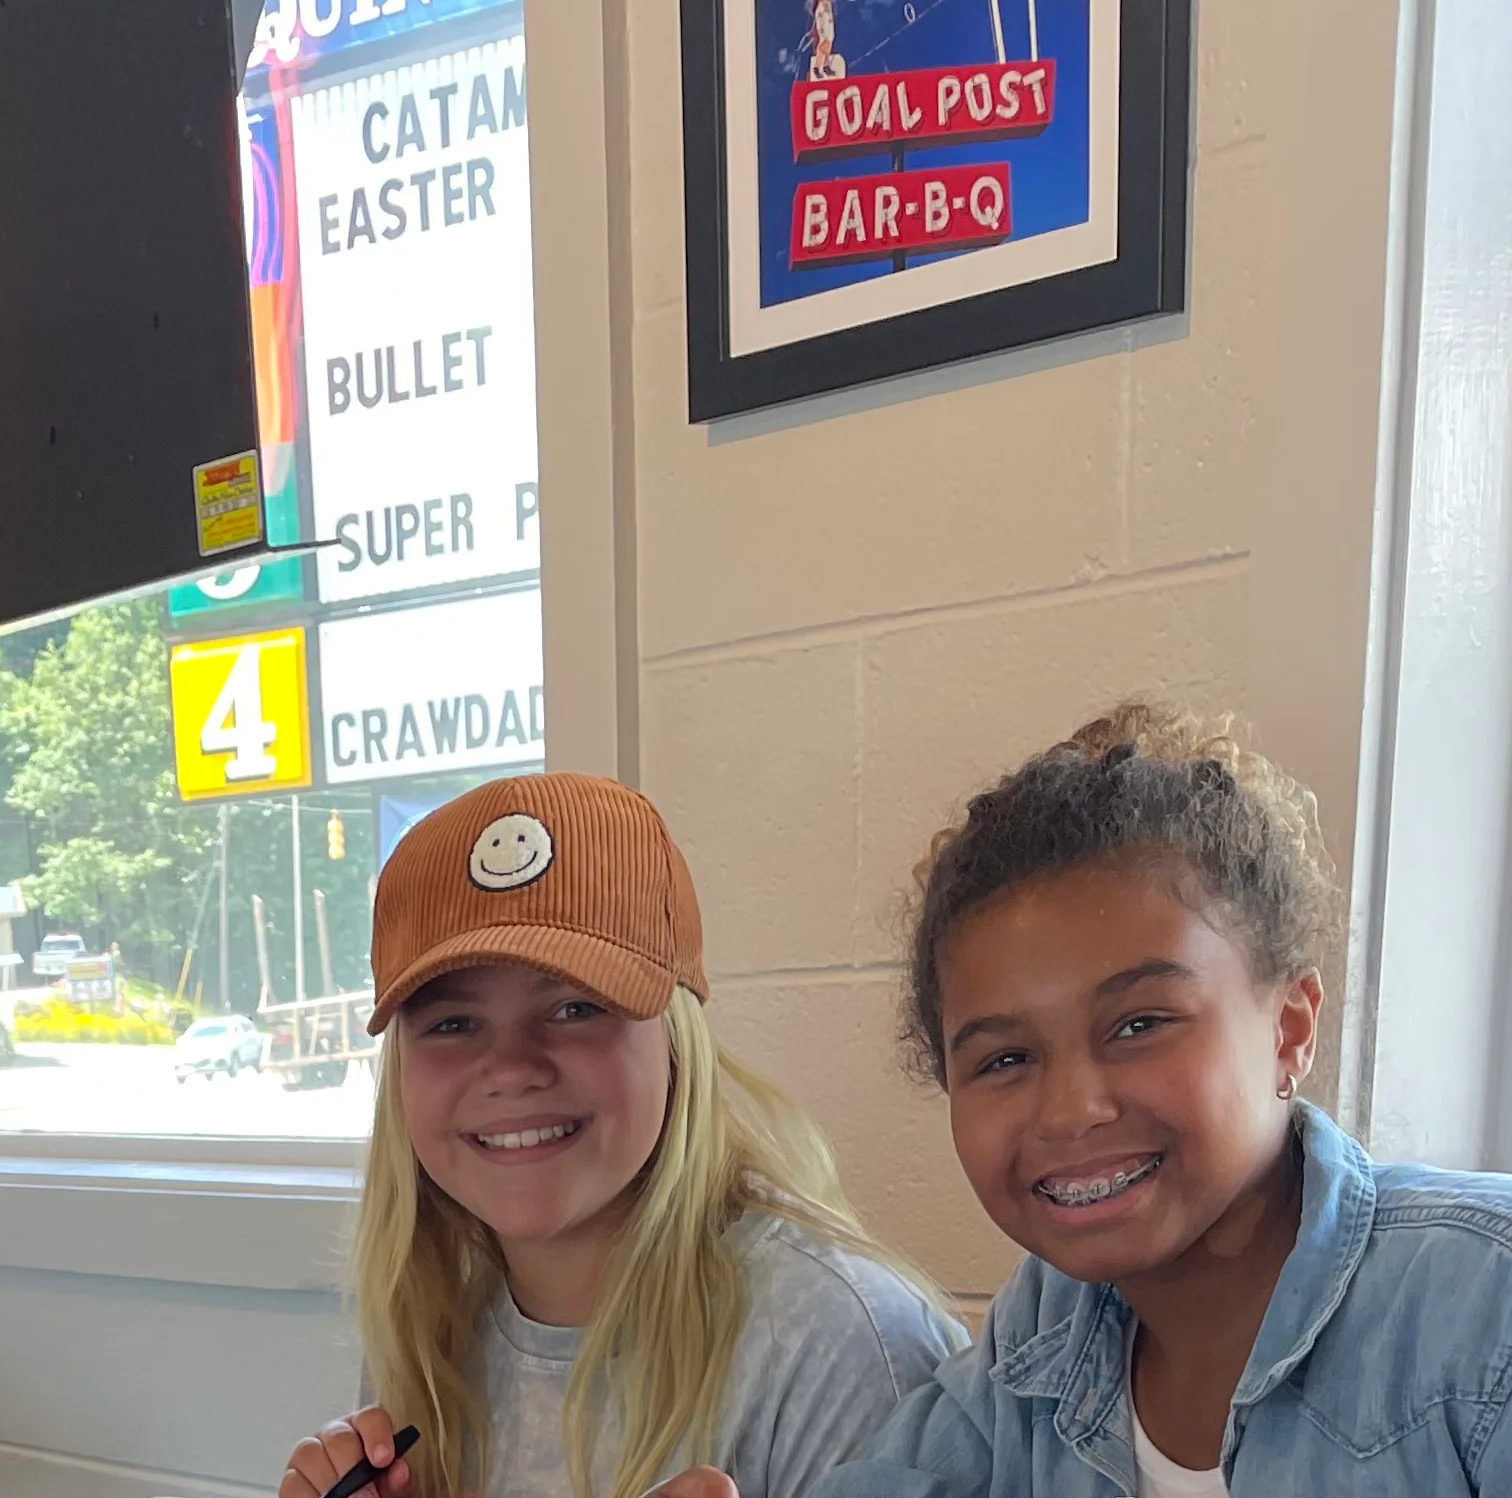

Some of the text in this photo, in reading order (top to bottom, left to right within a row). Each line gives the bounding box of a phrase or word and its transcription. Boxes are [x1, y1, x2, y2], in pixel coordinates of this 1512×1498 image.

[804, 69, 1047, 142] GOAL POST
[319, 156, 496, 256] EASTER
[327, 325, 493, 416] BULLET
[336, 493, 474, 573] SUPER
[515, 482, 539, 541] P
[200, 643, 277, 783] 4
